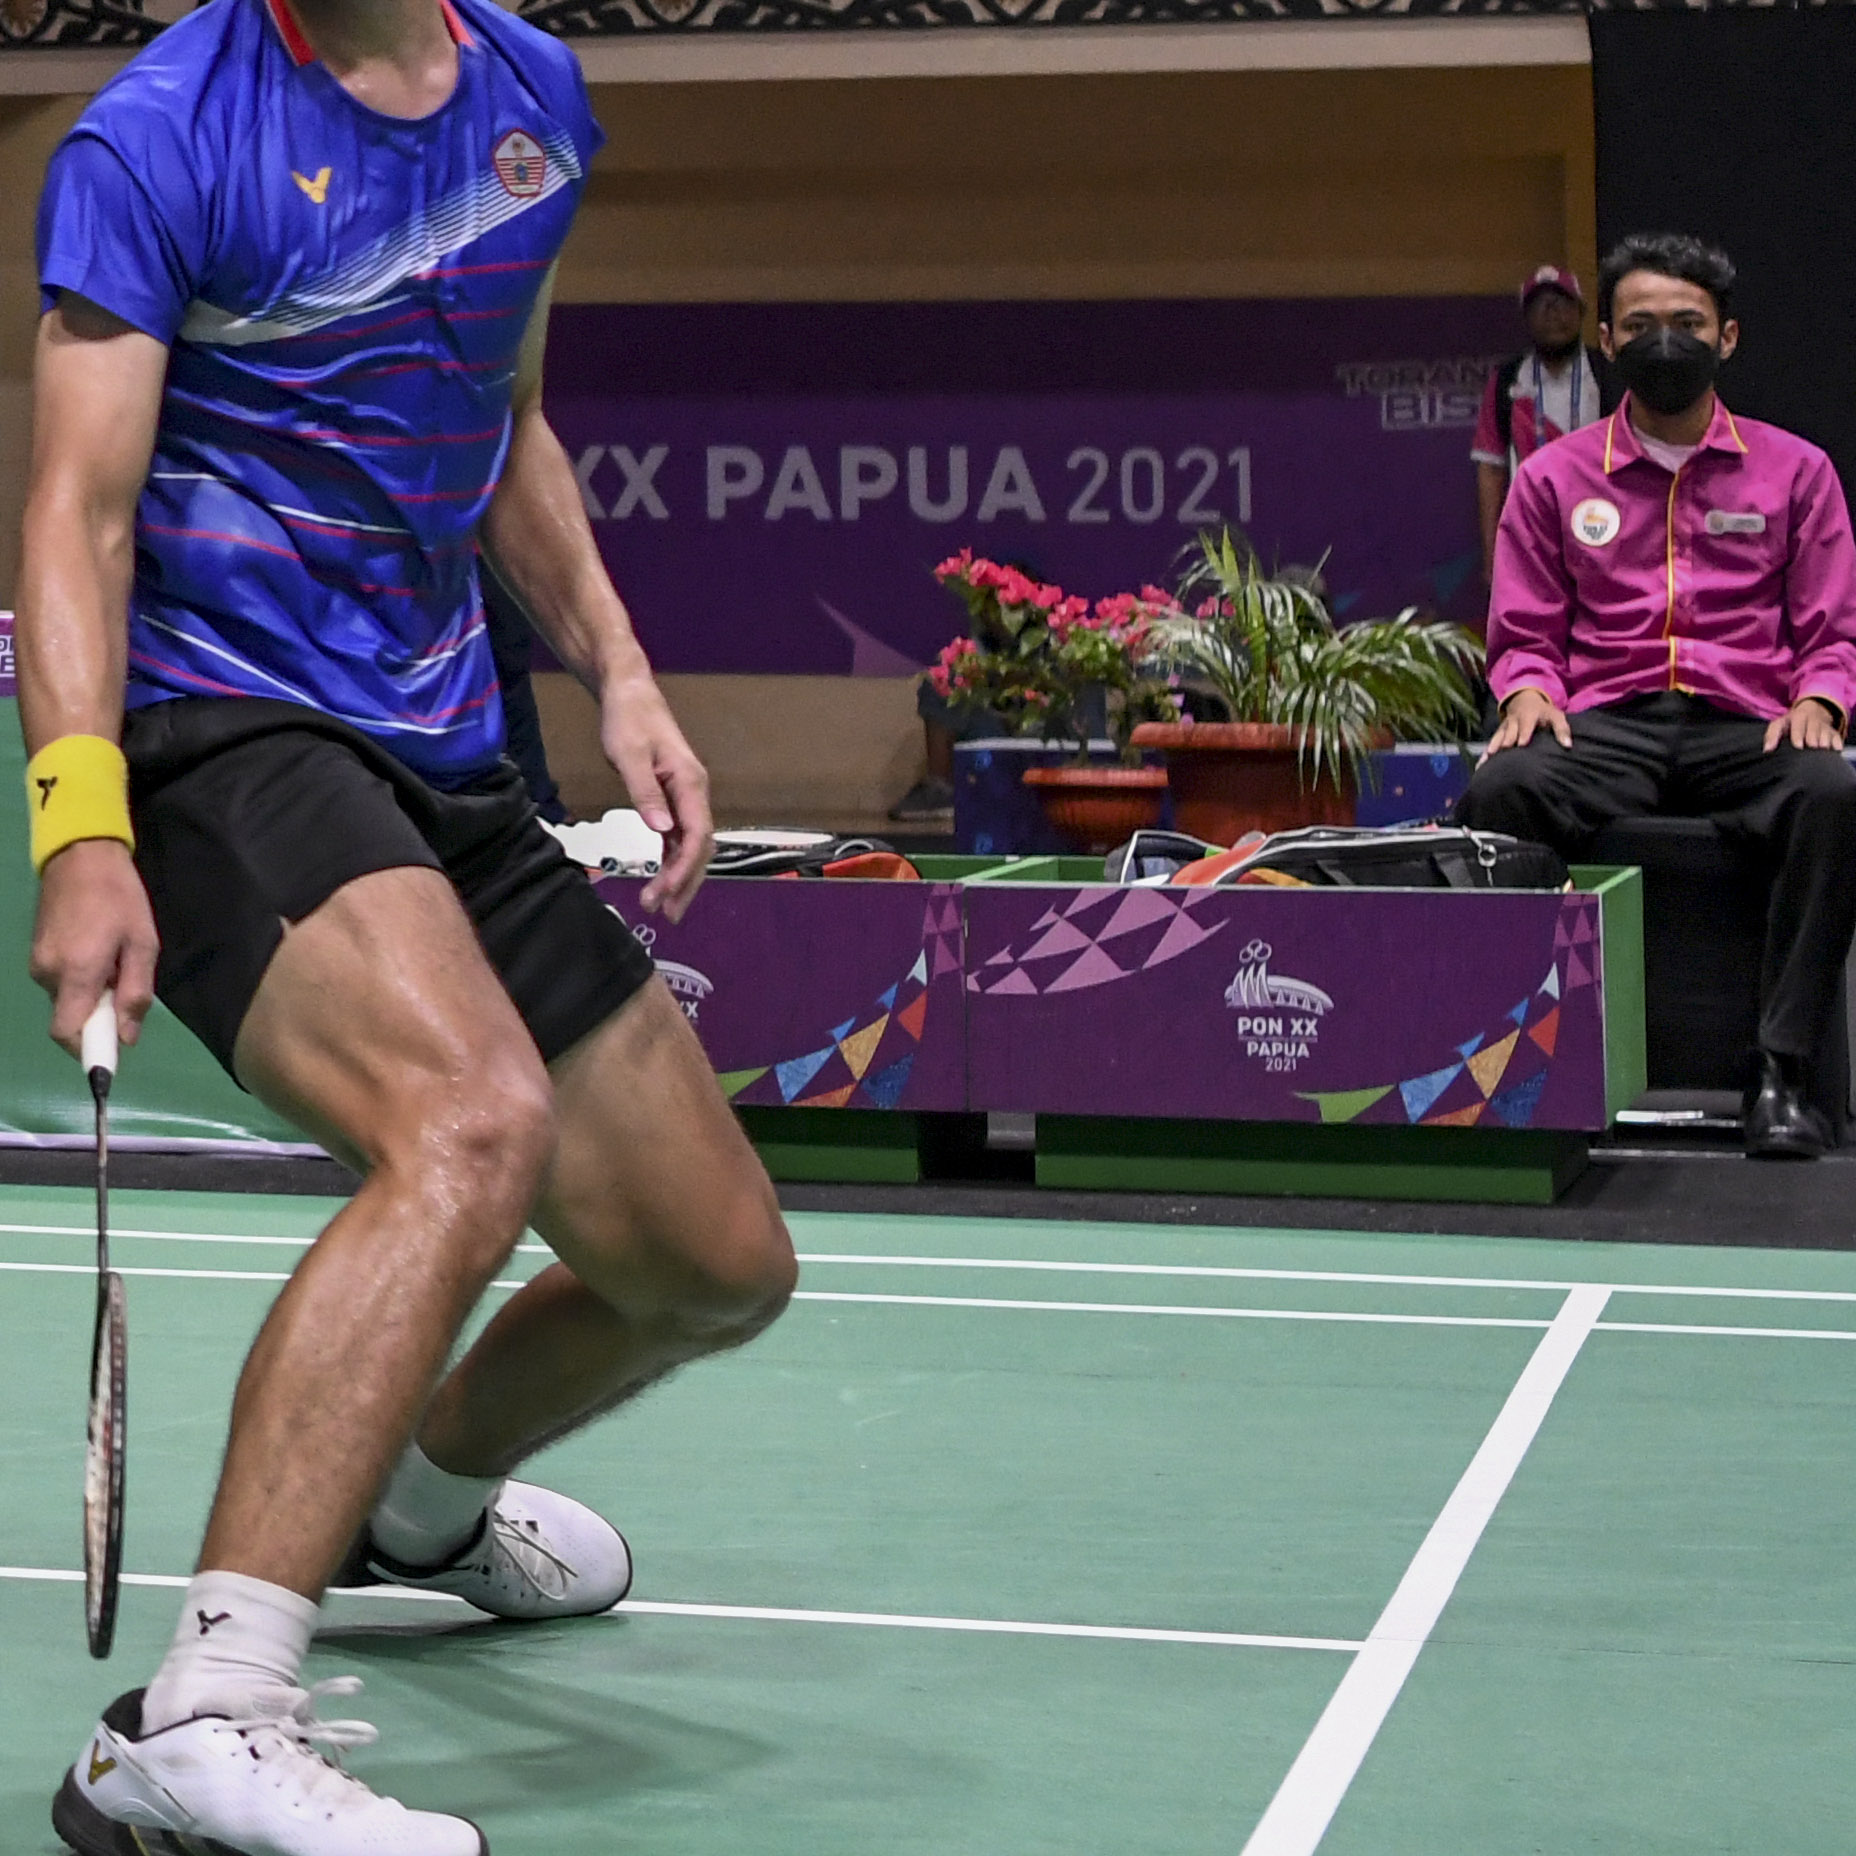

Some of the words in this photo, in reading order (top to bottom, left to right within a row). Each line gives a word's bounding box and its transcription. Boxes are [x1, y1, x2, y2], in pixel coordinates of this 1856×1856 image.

[706, 446, 1047, 523] PAPUA
[1066, 447, 1252, 524] 2021
[1237, 1016, 1283, 1036] PON
[1290, 1017, 1318, 1036] XX
[1246, 1041, 1310, 1058] PAPUA
[1264, 1056, 1297, 1072] 2021
